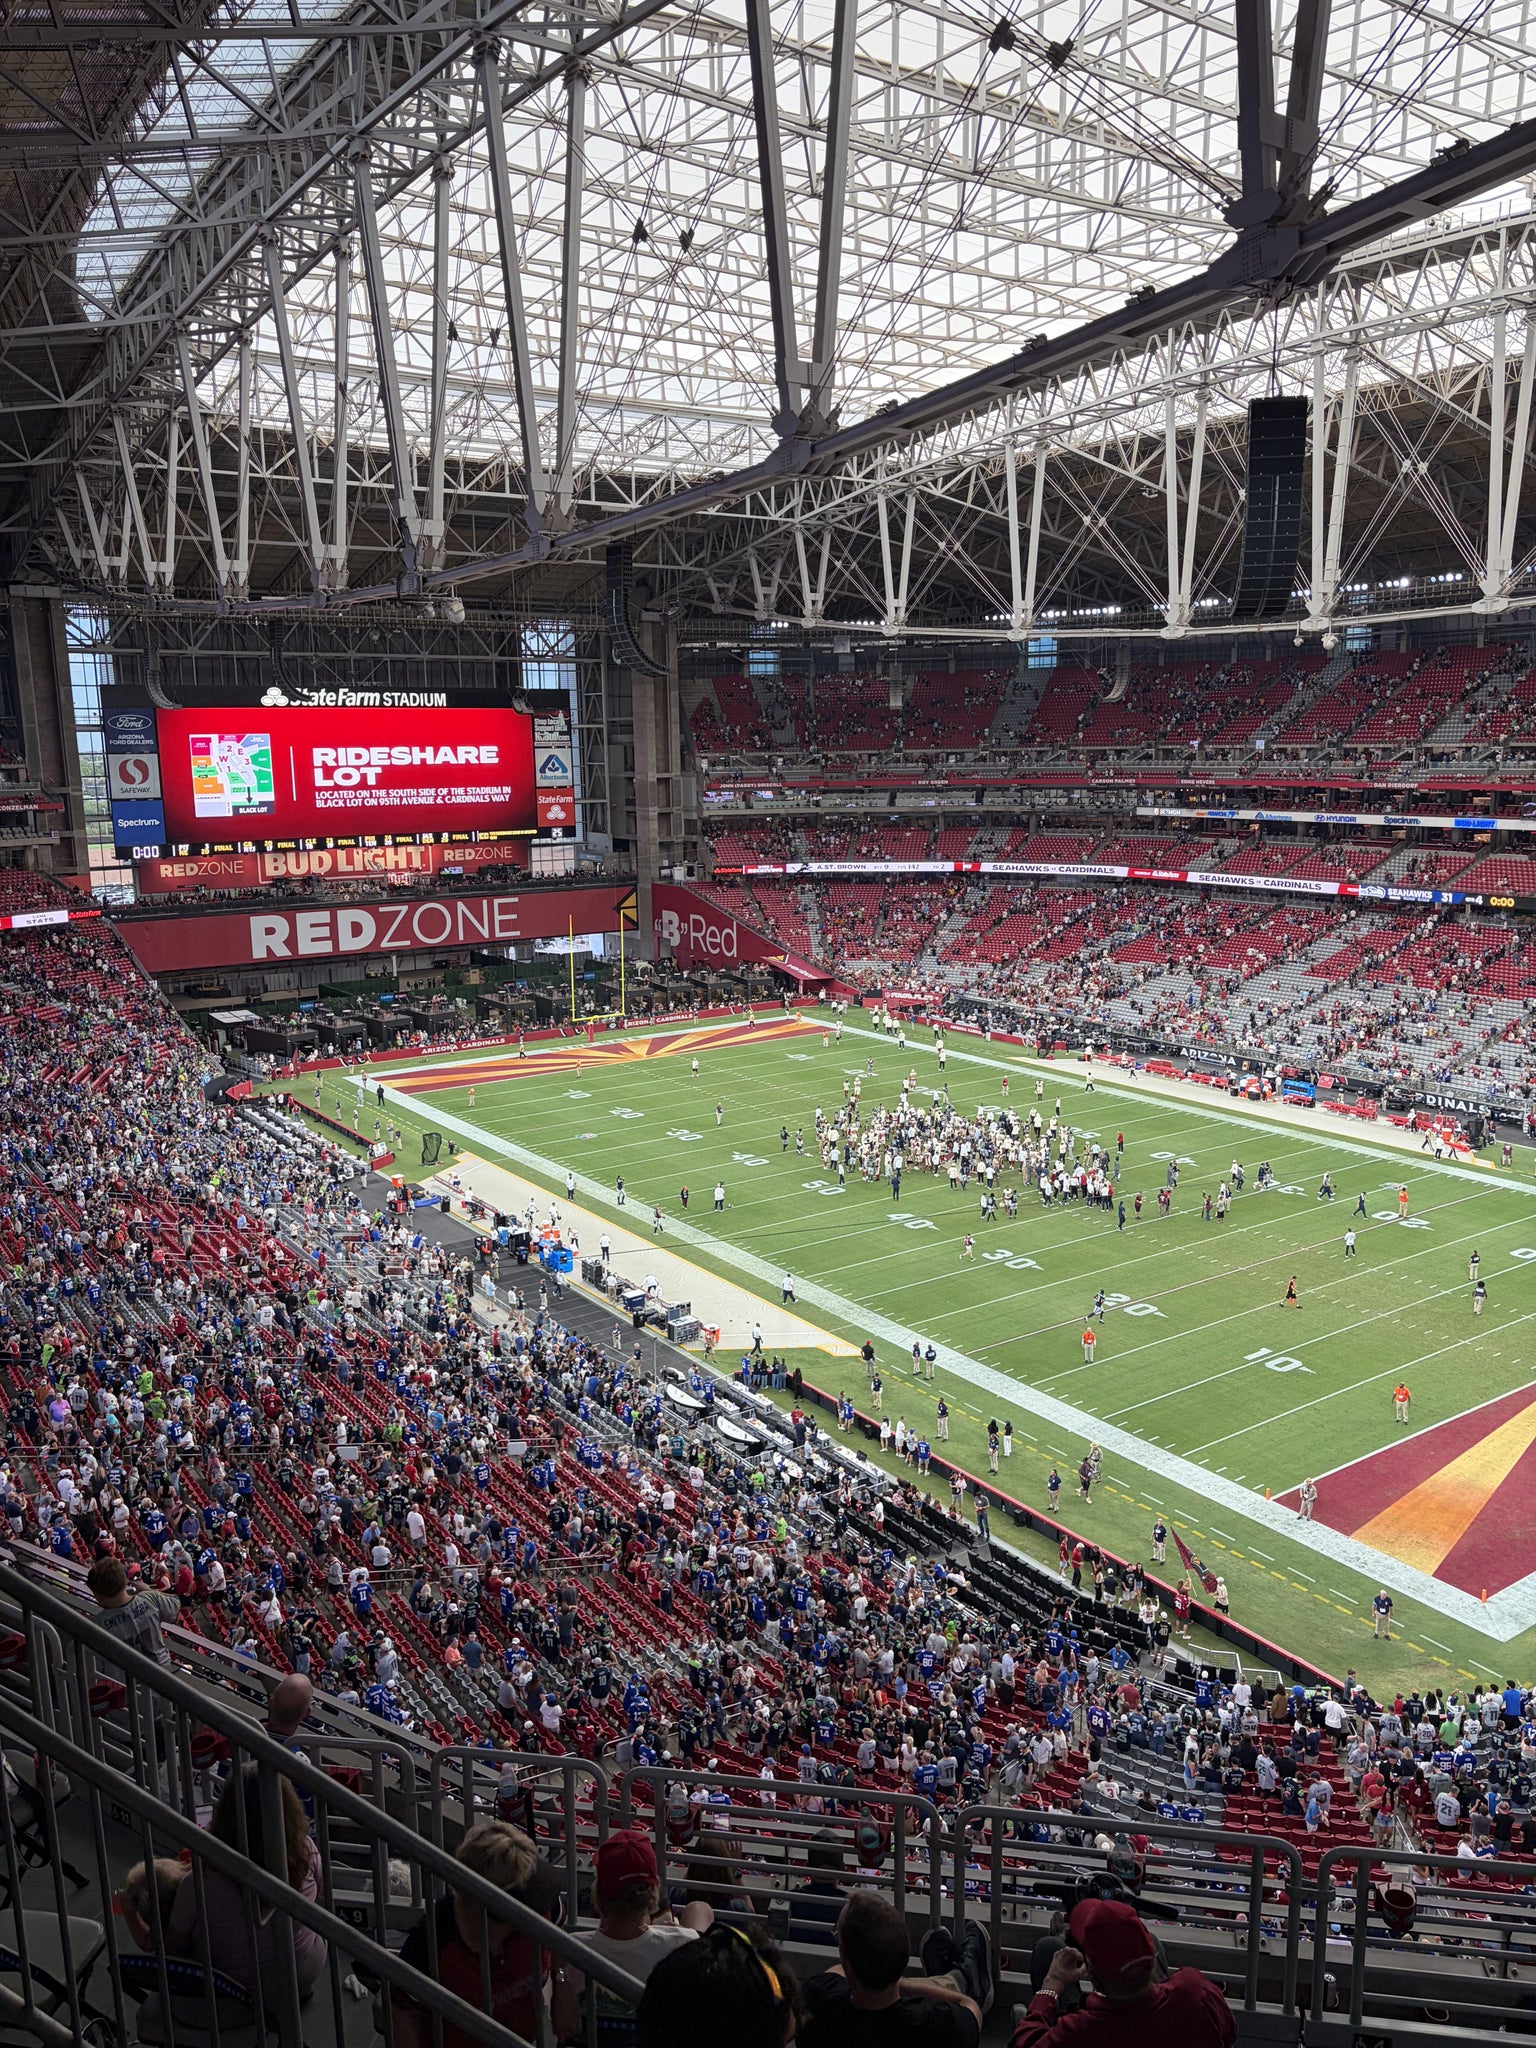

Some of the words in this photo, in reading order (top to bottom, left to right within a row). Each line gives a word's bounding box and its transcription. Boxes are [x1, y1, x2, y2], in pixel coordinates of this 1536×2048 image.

[382, 692, 447, 707] STADIUM
[116, 716, 143, 728] Ford
[312, 745, 499, 767] RIDESHARE
[314, 766, 382, 787] LOT
[315, 790, 355, 800] LOCATED
[356, 790, 370, 798] ON
[371, 789, 387, 798] THE
[388, 788, 417, 798] SOUTH
[418, 787, 436, 797] SIDE
[437, 787, 449, 796] OF
[450, 786, 465, 796] THE
[466, 786, 501, 795] STADIUM
[503, 786, 511, 794] IN
[316, 799, 345, 808] BLACK
[346, 798, 362, 807] LOT
[364, 798, 378, 807] ON
[379, 797, 400, 806] 95TH
[402, 796, 435, 805] AVENUE
[436, 796, 444, 804] &
[444, 794, 490, 804] CARDINALS
[491, 794, 510, 803] WAY
[118, 819, 157, 828] Spectrum
[1264, 813, 1293, 821] Albertsons
[1383, 816, 1419, 825] Spectrum
[1454, 819, 1472, 828] BUD
[1472, 819, 1496, 828] LIGHT
[551, 827, 563, 837] 25
[132, 845, 159, 859] 0:00
[264, 849, 333, 876] BUD
[335, 845, 424, 872] LIGHT
[992, 864, 1050, 872] SEAHAWKS
[1058, 865, 1115, 874] CARDINALS
[1198, 874, 1255, 886] SEAHAWKS
[1263, 879, 1322, 891] CARDINALS
[1387, 887, 1433, 899] SEAHAWKS
[1441, 892, 1453, 903] 31
[1475, 895, 1483, 905] 4
[1489, 896, 1515, 908] 0:00
[26, 917, 55, 925] STATS
[689, 914, 738, 958] Red
[655, 1013, 694, 1024] CARDINALS
[421, 1043, 459, 1055] ARIZONA
[460, 1037, 506, 1050] CARDINALS
[801, 1180, 846, 1196] 50
[886, 1213, 935, 1230] 40
[981, 1249, 1037, 1270] 30
[1101, 1293, 1160, 1317] 20
[1243, 1347, 1304, 1373] 10
[359, 1592, 367, 1601] 11
[1198, 1687, 1206, 1697] 11
[372, 1695, 380, 1705] 3
[1091, 1714, 1104, 1727] 84
[972, 1751, 984, 1763] 28
[923, 1774, 934, 1784] 80
[1106, 1787, 1115, 1798] 3
[1414, 1787, 1422, 1797] 4
[352, 1910, 363, 1923] 9
